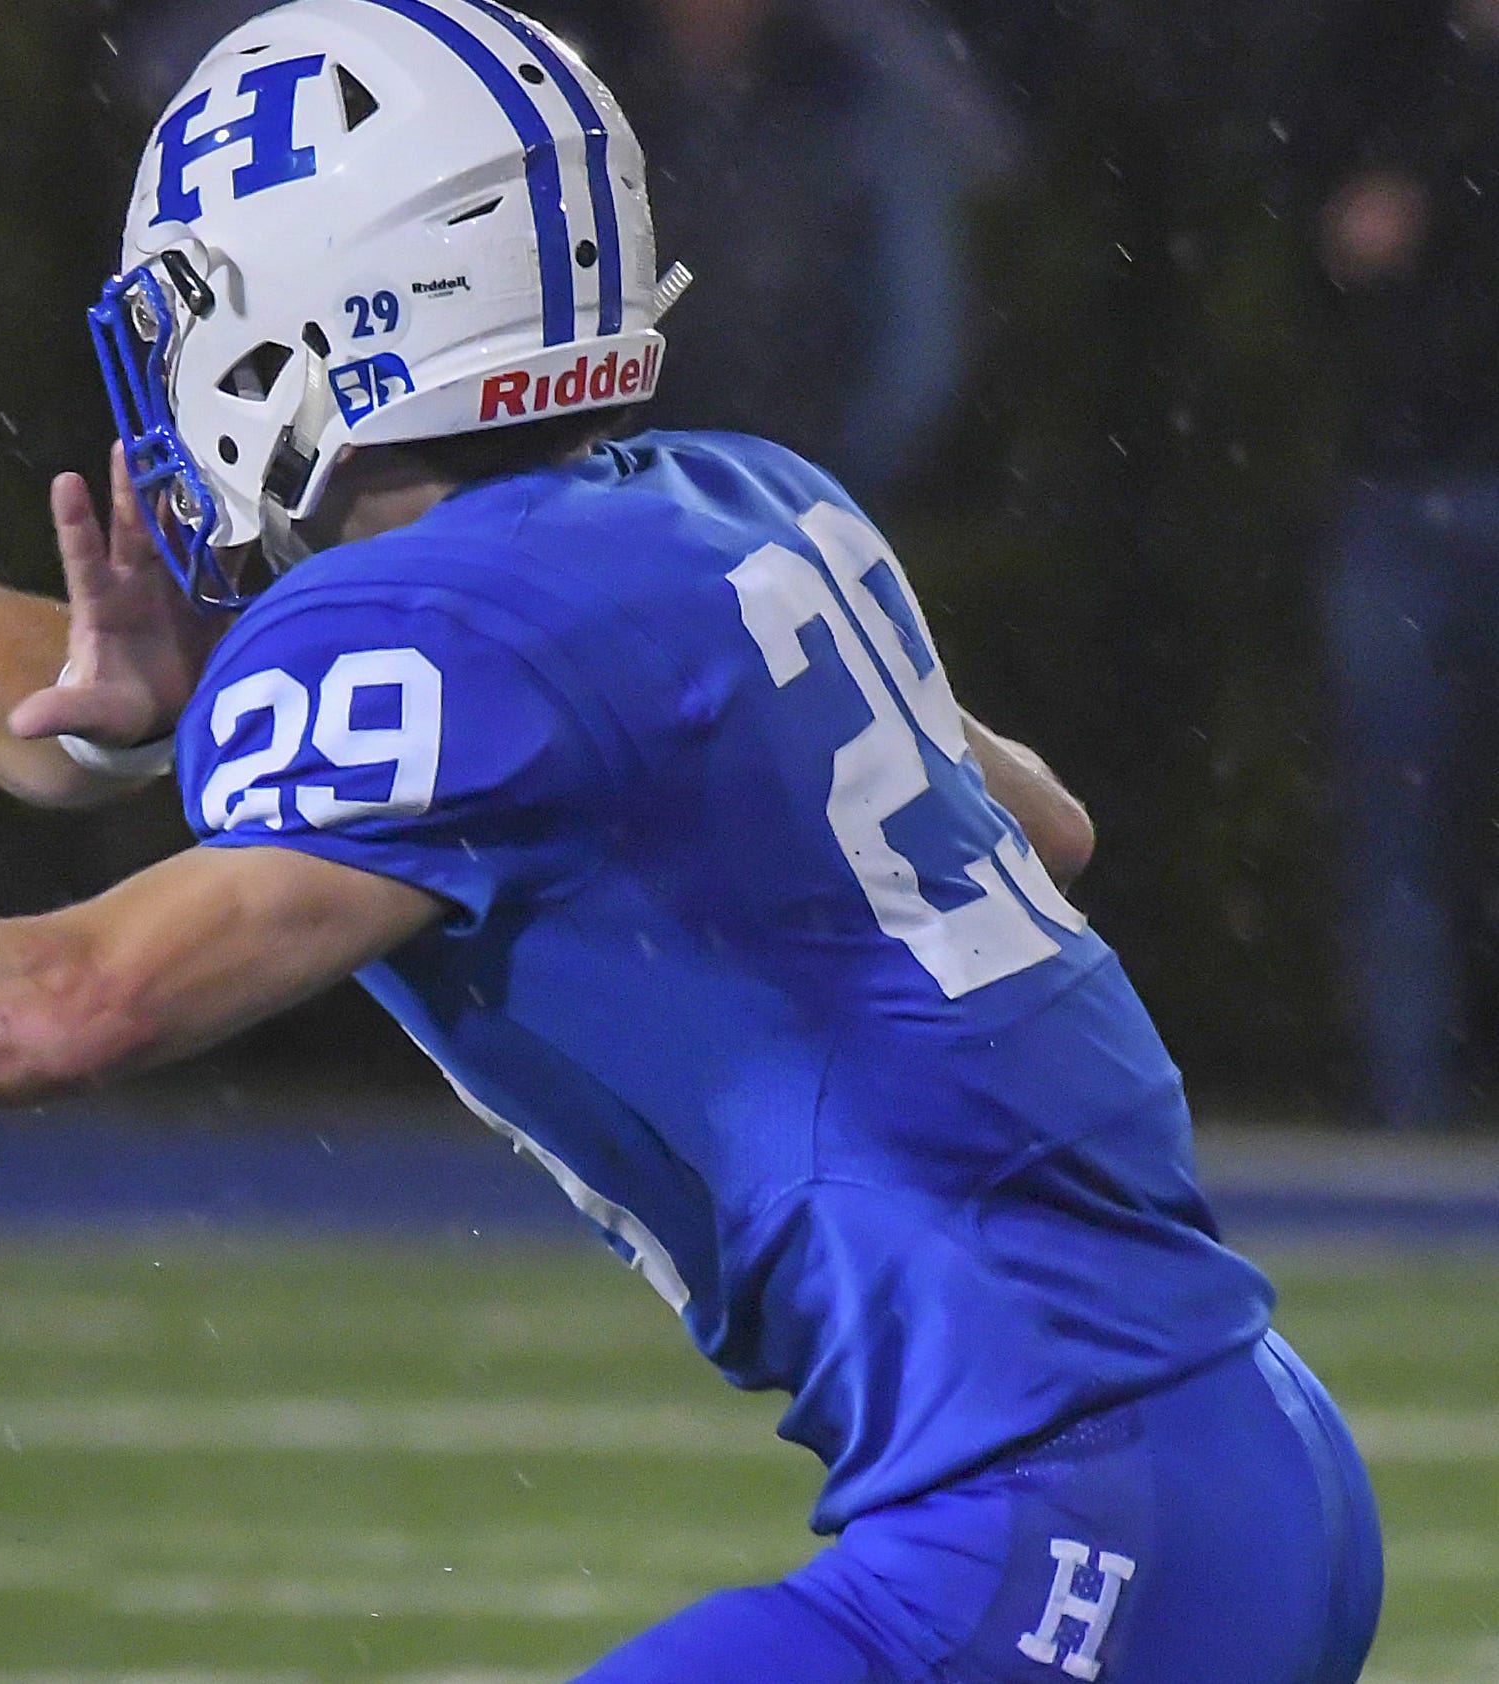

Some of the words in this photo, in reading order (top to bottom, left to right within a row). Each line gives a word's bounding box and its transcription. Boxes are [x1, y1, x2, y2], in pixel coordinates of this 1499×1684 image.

[149, 53, 326, 227] H
[345, 290, 399, 338] 29
[480, 344, 659, 422] Riddell
[200, 647, 442, 832] 29
[1017, 1538, 1136, 1682] H
